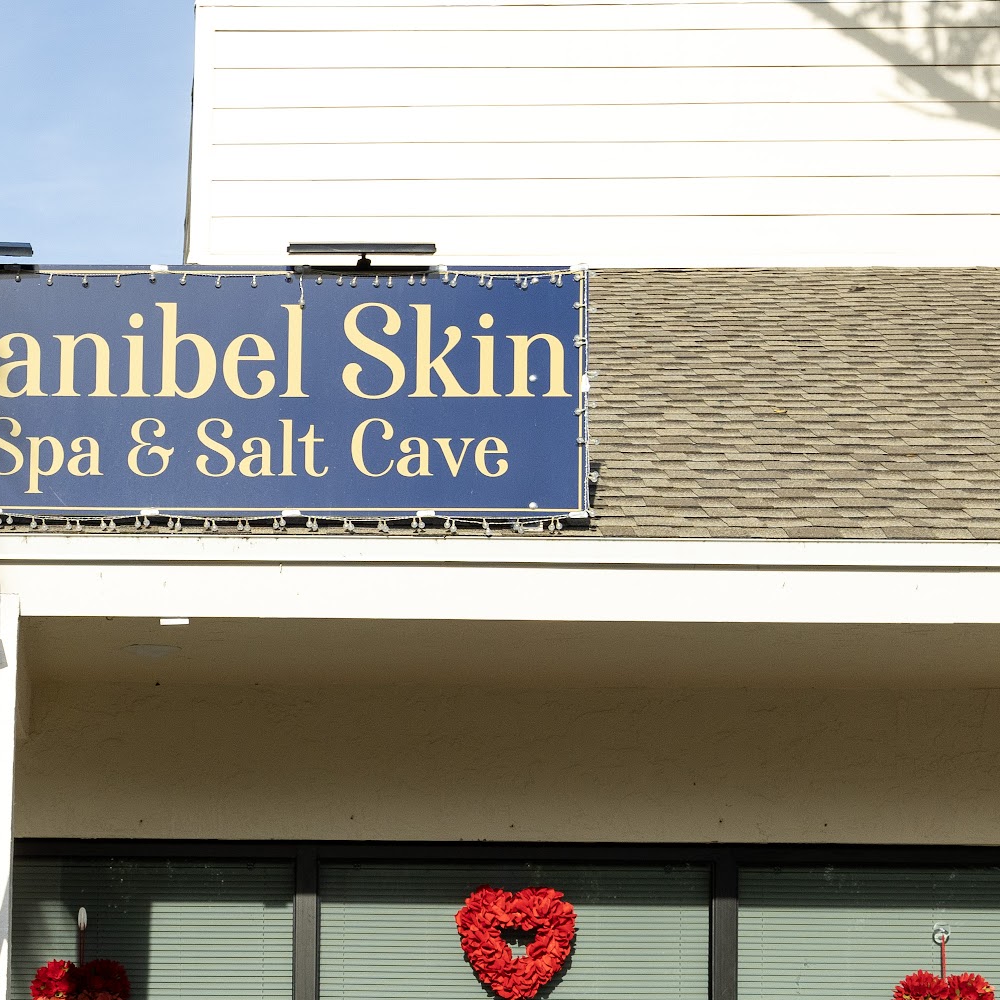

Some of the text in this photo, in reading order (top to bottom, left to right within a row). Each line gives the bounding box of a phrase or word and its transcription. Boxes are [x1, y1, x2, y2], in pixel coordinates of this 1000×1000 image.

[342, 301, 574, 400] Skin
[127, 417, 175, 478] &
[195, 417, 330, 478] Salt
[350, 417, 511, 479] Cave
